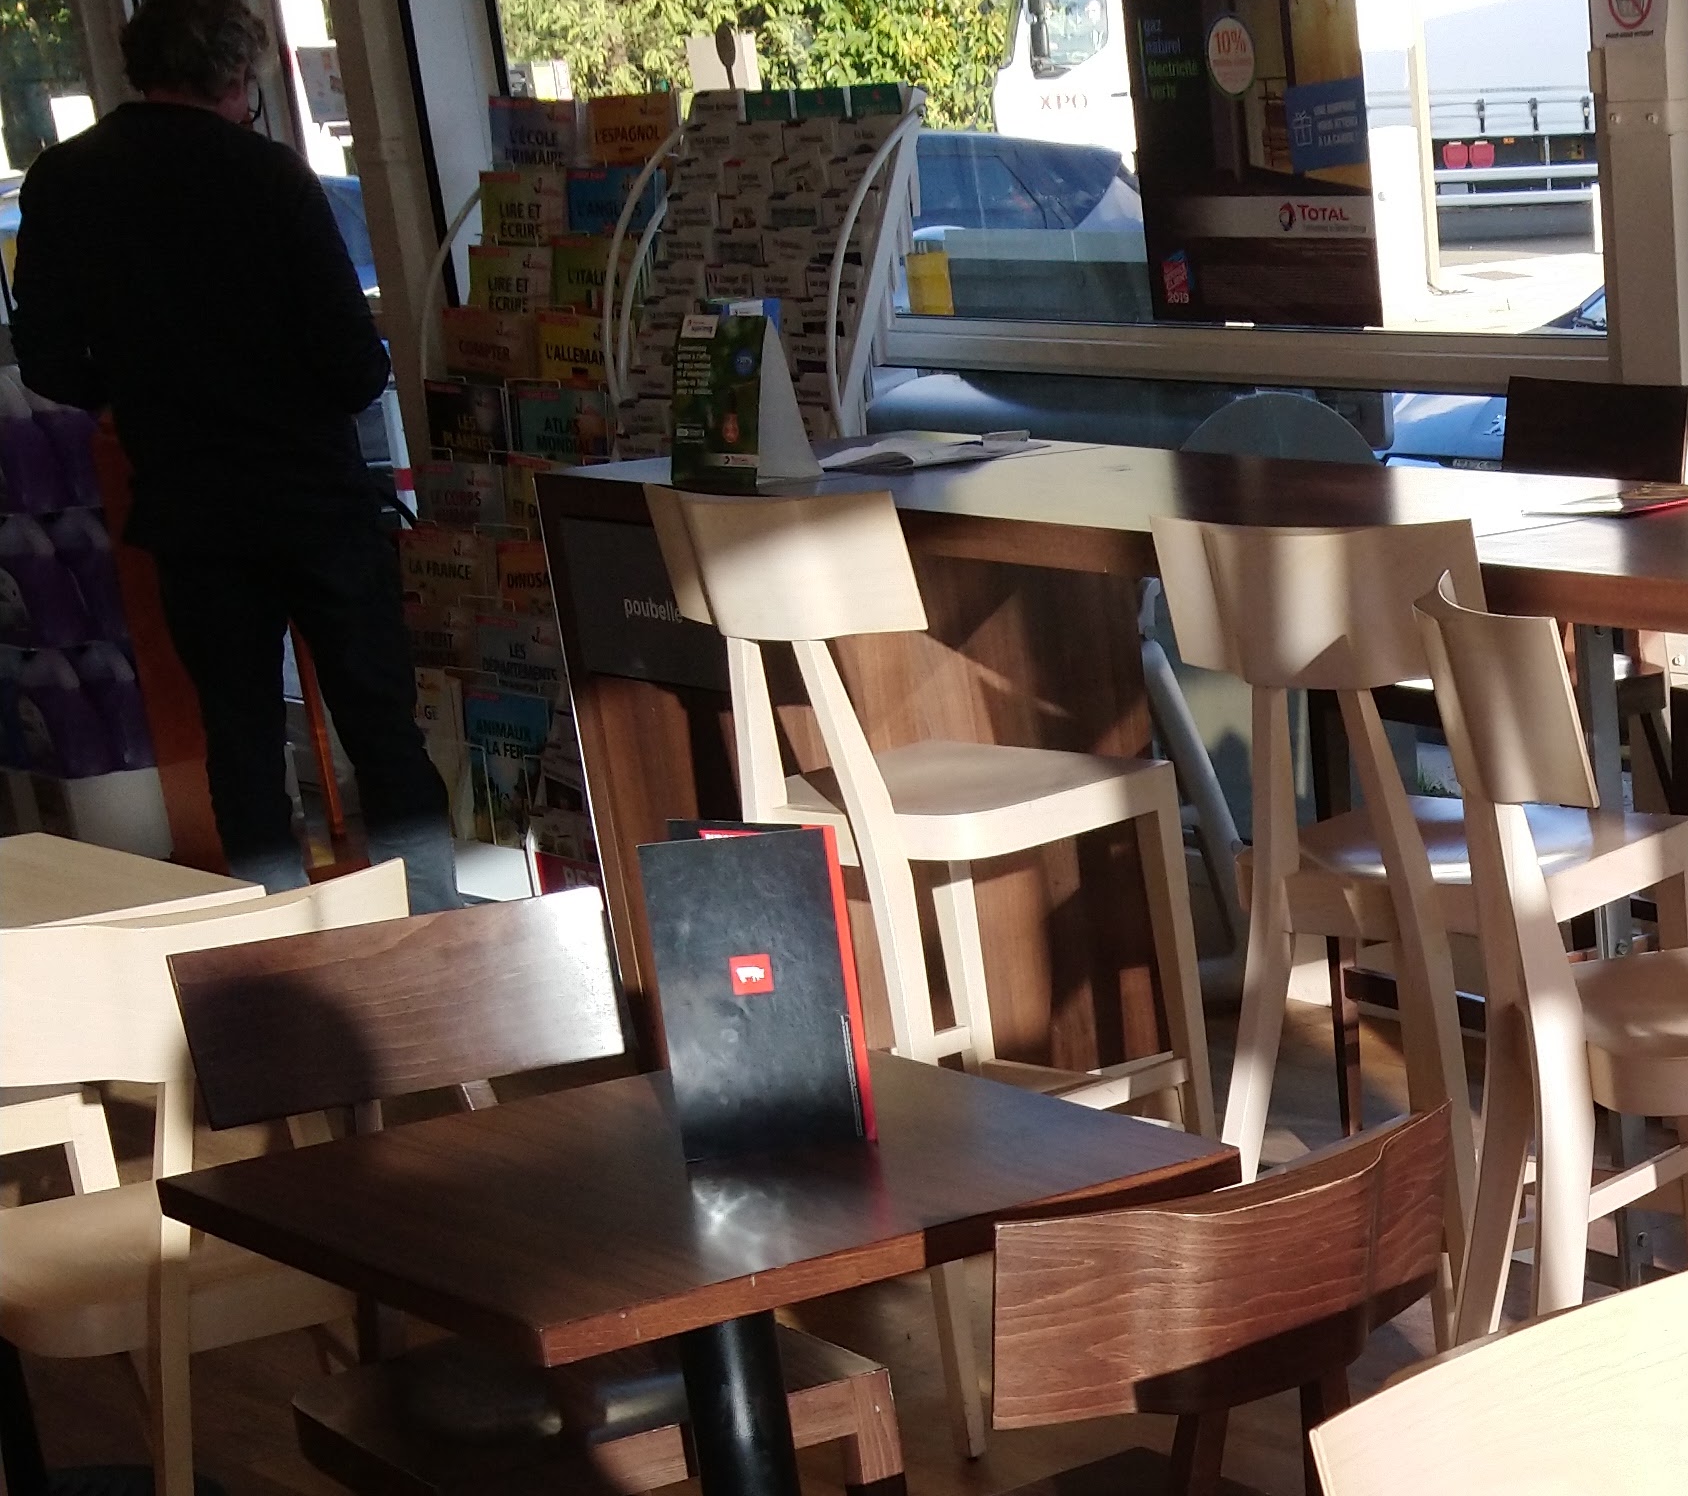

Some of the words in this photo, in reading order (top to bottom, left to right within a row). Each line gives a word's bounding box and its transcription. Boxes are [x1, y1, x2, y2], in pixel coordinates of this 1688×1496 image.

[1213, 27, 1247, 55] 10%
[595, 124, 660, 143] L'ESPAGNOL
[500, 203, 525, 218] LIRE
[528, 204, 542, 219] ET
[1297, 204, 1349, 222] TOTAL
[488, 276, 512, 292] LIRE
[516, 277, 528, 293] ET
[1167, 293, 1190, 305] 2019
[546, 343, 614, 366] L'ALLEMAN
[544, 416, 580, 434] ATLAS
[409, 557, 424, 575] LA
[426, 560, 472, 581] FRANCE
[623, 596, 683, 624] poubelle
[509, 642, 526, 660] LES
